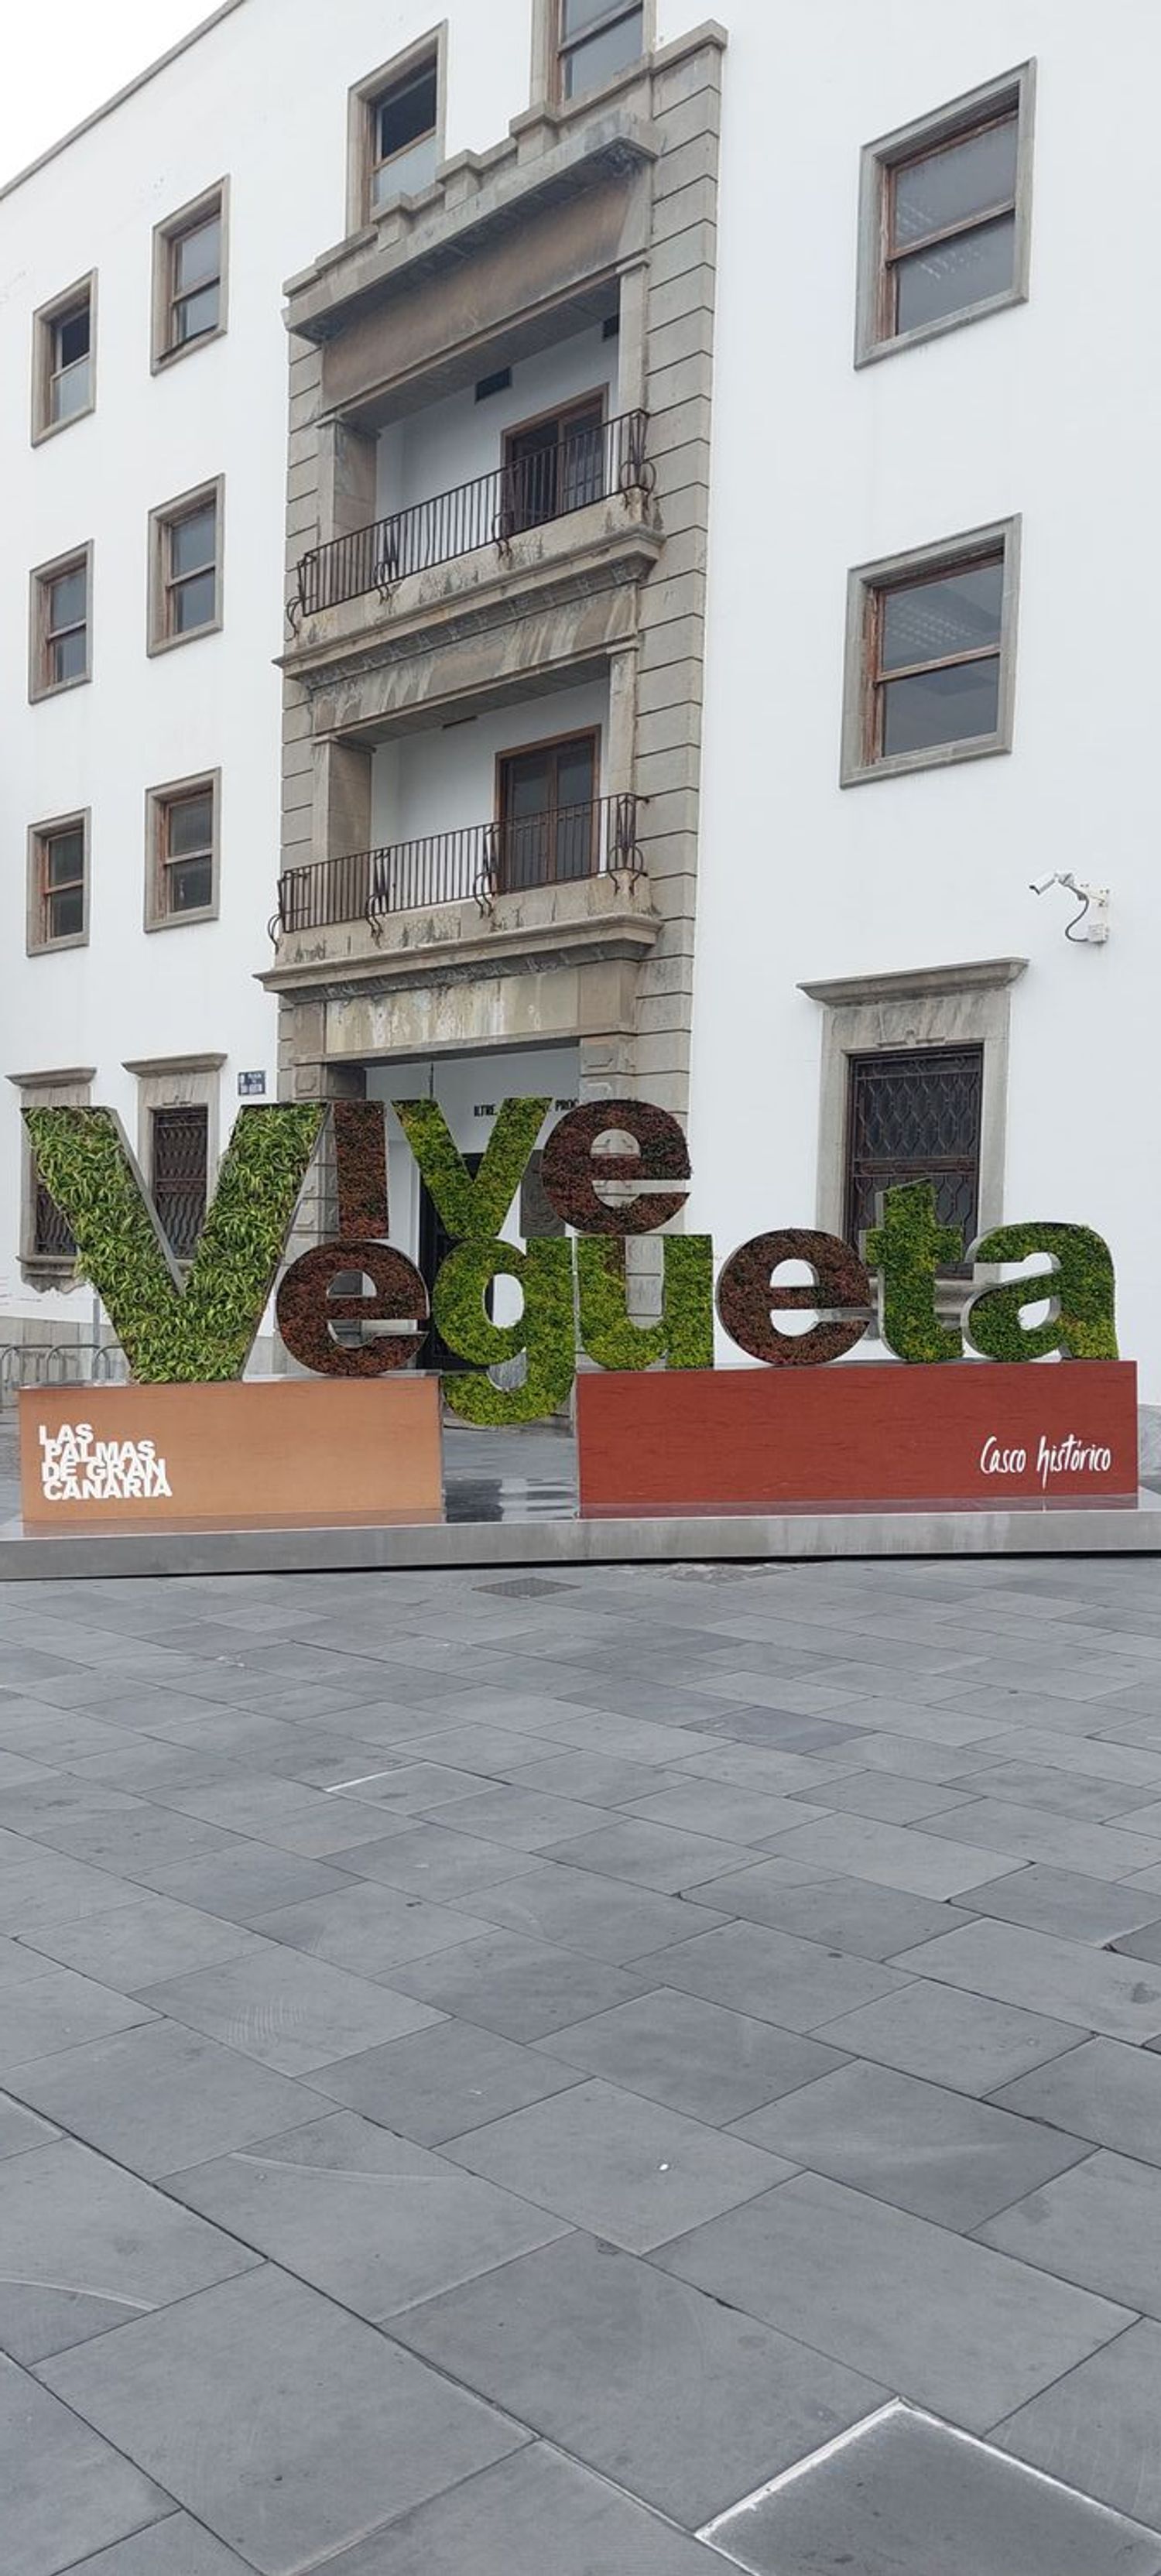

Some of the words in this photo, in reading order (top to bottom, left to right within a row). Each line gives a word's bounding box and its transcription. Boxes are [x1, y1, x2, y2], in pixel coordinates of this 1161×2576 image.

[39, 1423, 94, 1446] LAS
[44, 1440, 156, 1463] PALMAS
[980, 1435, 1026, 1474] Casco
[1036, 1434, 1111, 1489] histórico
[42, 1459, 77, 1482] DE
[86, 1456, 166, 1481] GRAN
[43, 1475, 173, 1500] CANARIA
